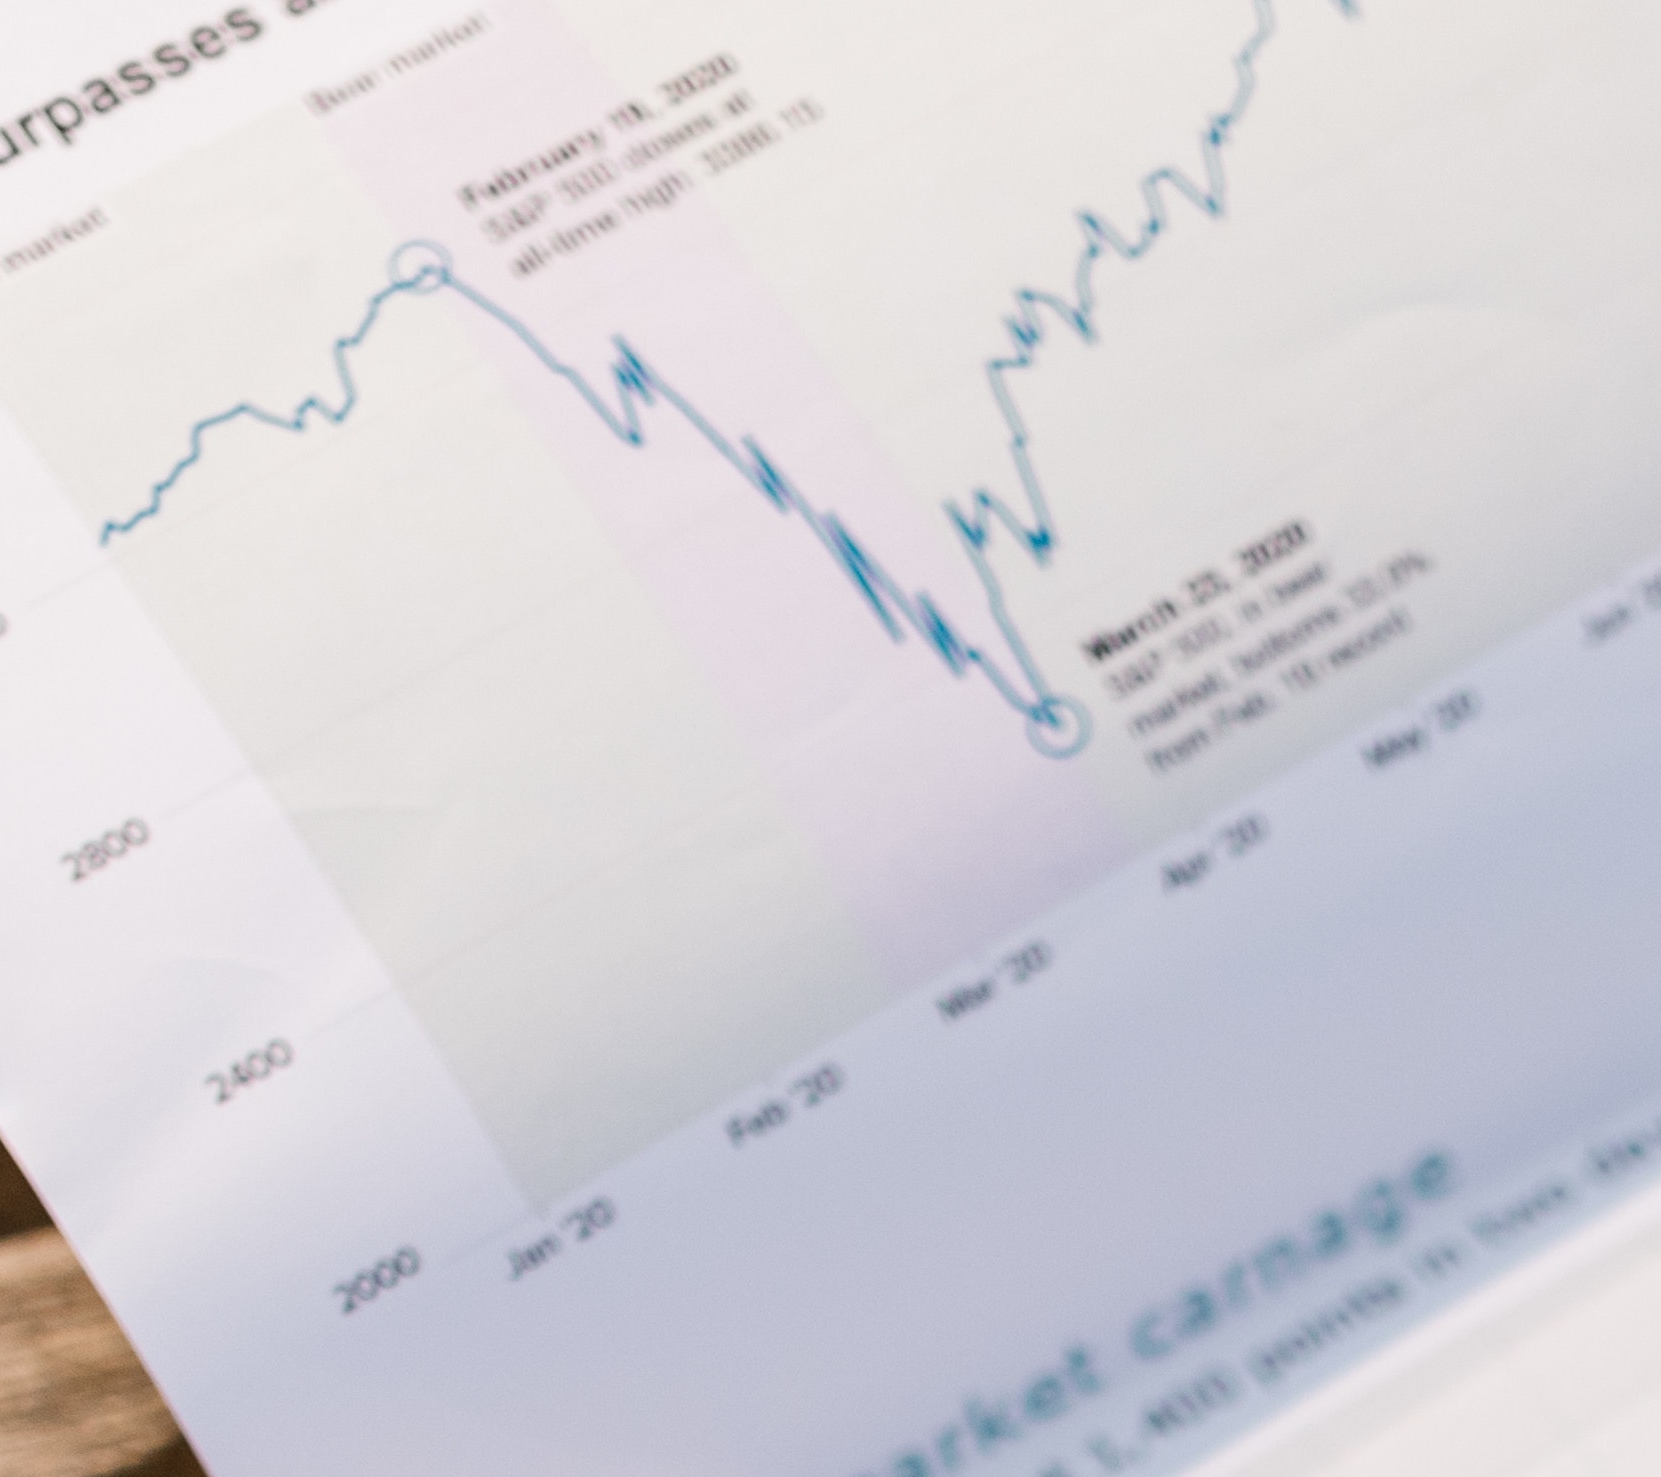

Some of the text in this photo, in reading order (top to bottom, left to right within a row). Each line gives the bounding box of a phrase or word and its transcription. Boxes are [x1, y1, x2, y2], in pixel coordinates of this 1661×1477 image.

[61, 818, 150, 883] 2800
[205, 1039, 293, 1105] 2400
[333, 1246, 422, 1316] 2000
[1129, 1150, 1456, 1362] carnage
